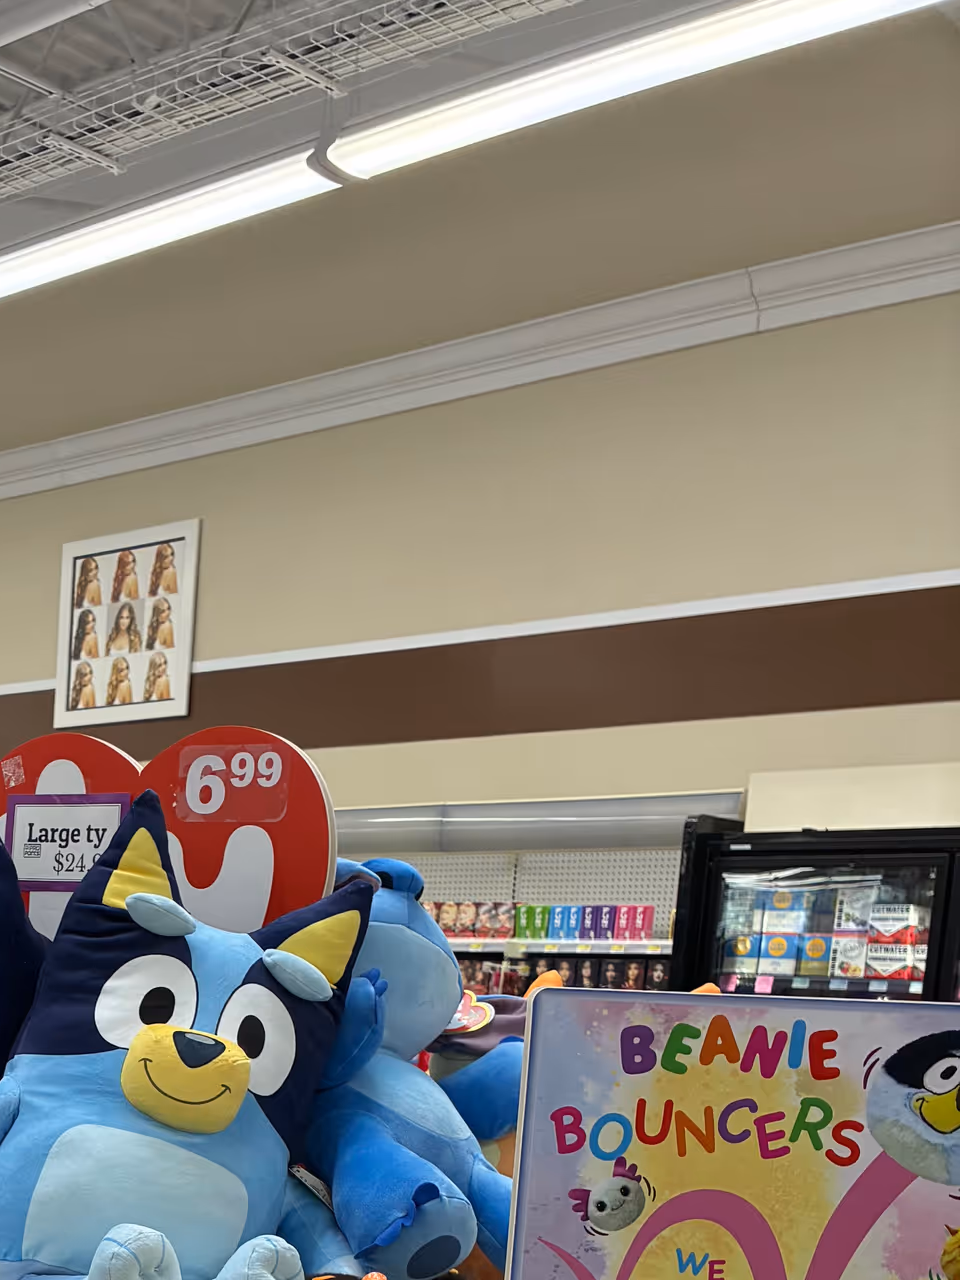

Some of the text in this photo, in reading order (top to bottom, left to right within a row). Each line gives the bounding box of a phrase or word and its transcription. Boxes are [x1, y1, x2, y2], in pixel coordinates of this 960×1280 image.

[26, 822, 107, 849] Large ty
[869, 945, 908, 954] CUTWATER
[619, 1014, 841, 1081] BEANIE
[549, 1096, 865, 1168] BOUNCERS
